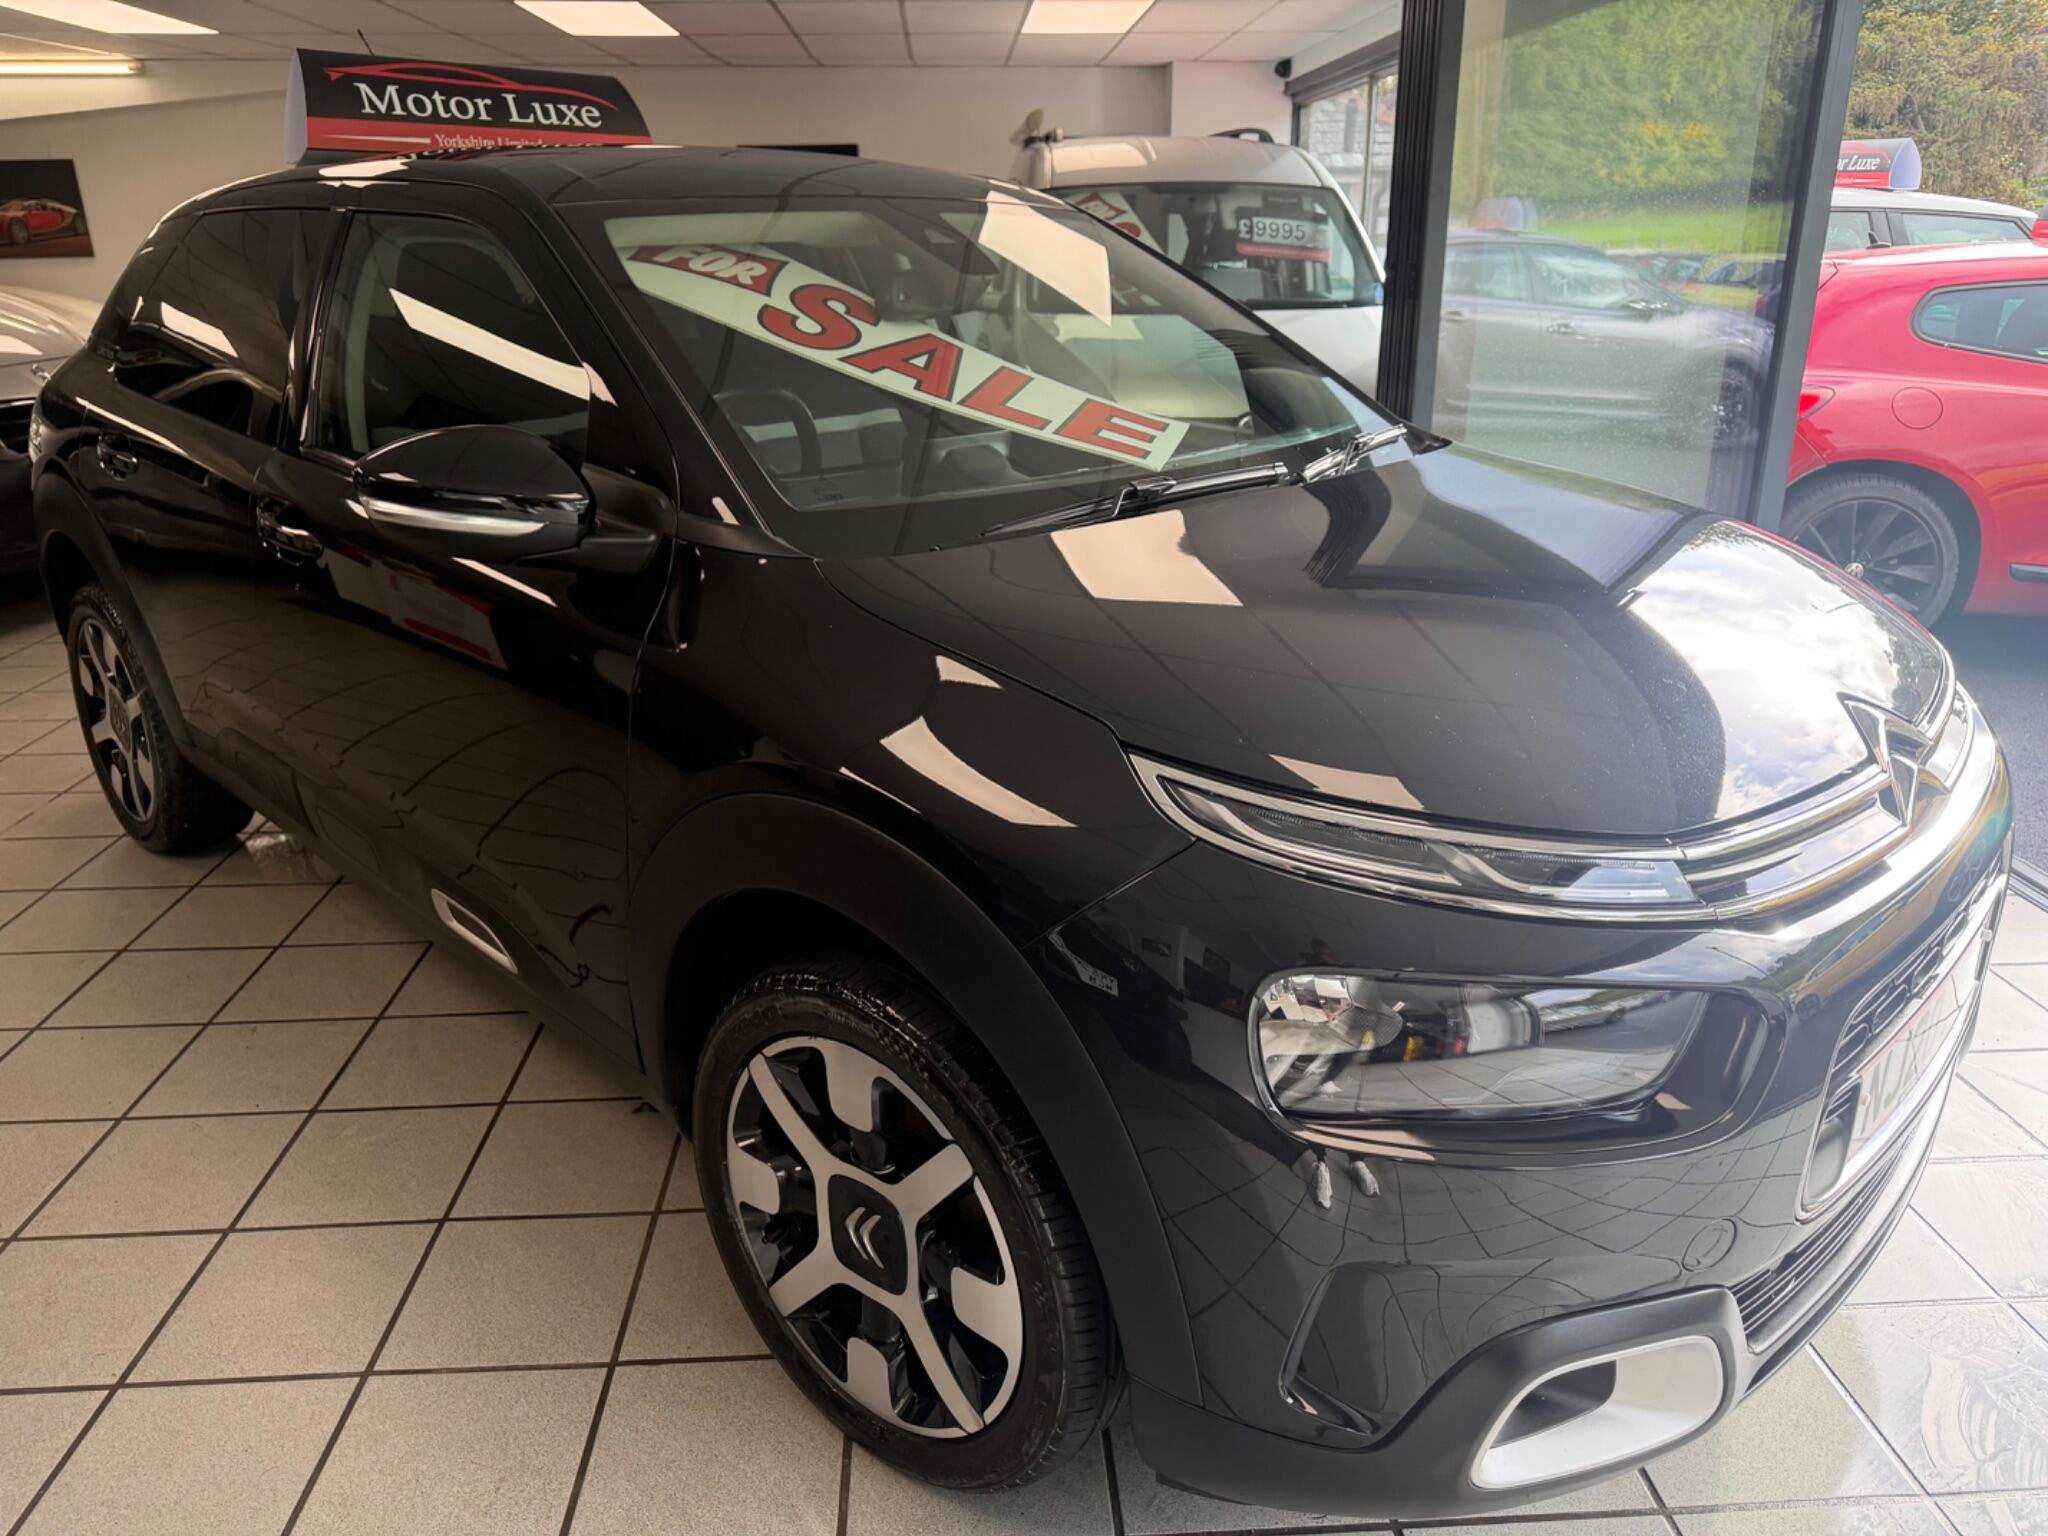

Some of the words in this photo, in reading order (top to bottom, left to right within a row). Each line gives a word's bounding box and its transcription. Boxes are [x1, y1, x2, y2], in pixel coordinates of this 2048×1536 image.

[353, 82, 492, 121] Motor
[501, 93, 603, 128] Luxe
[652, 245, 768, 285] FOR
[756, 282, 1169, 460] SALE
